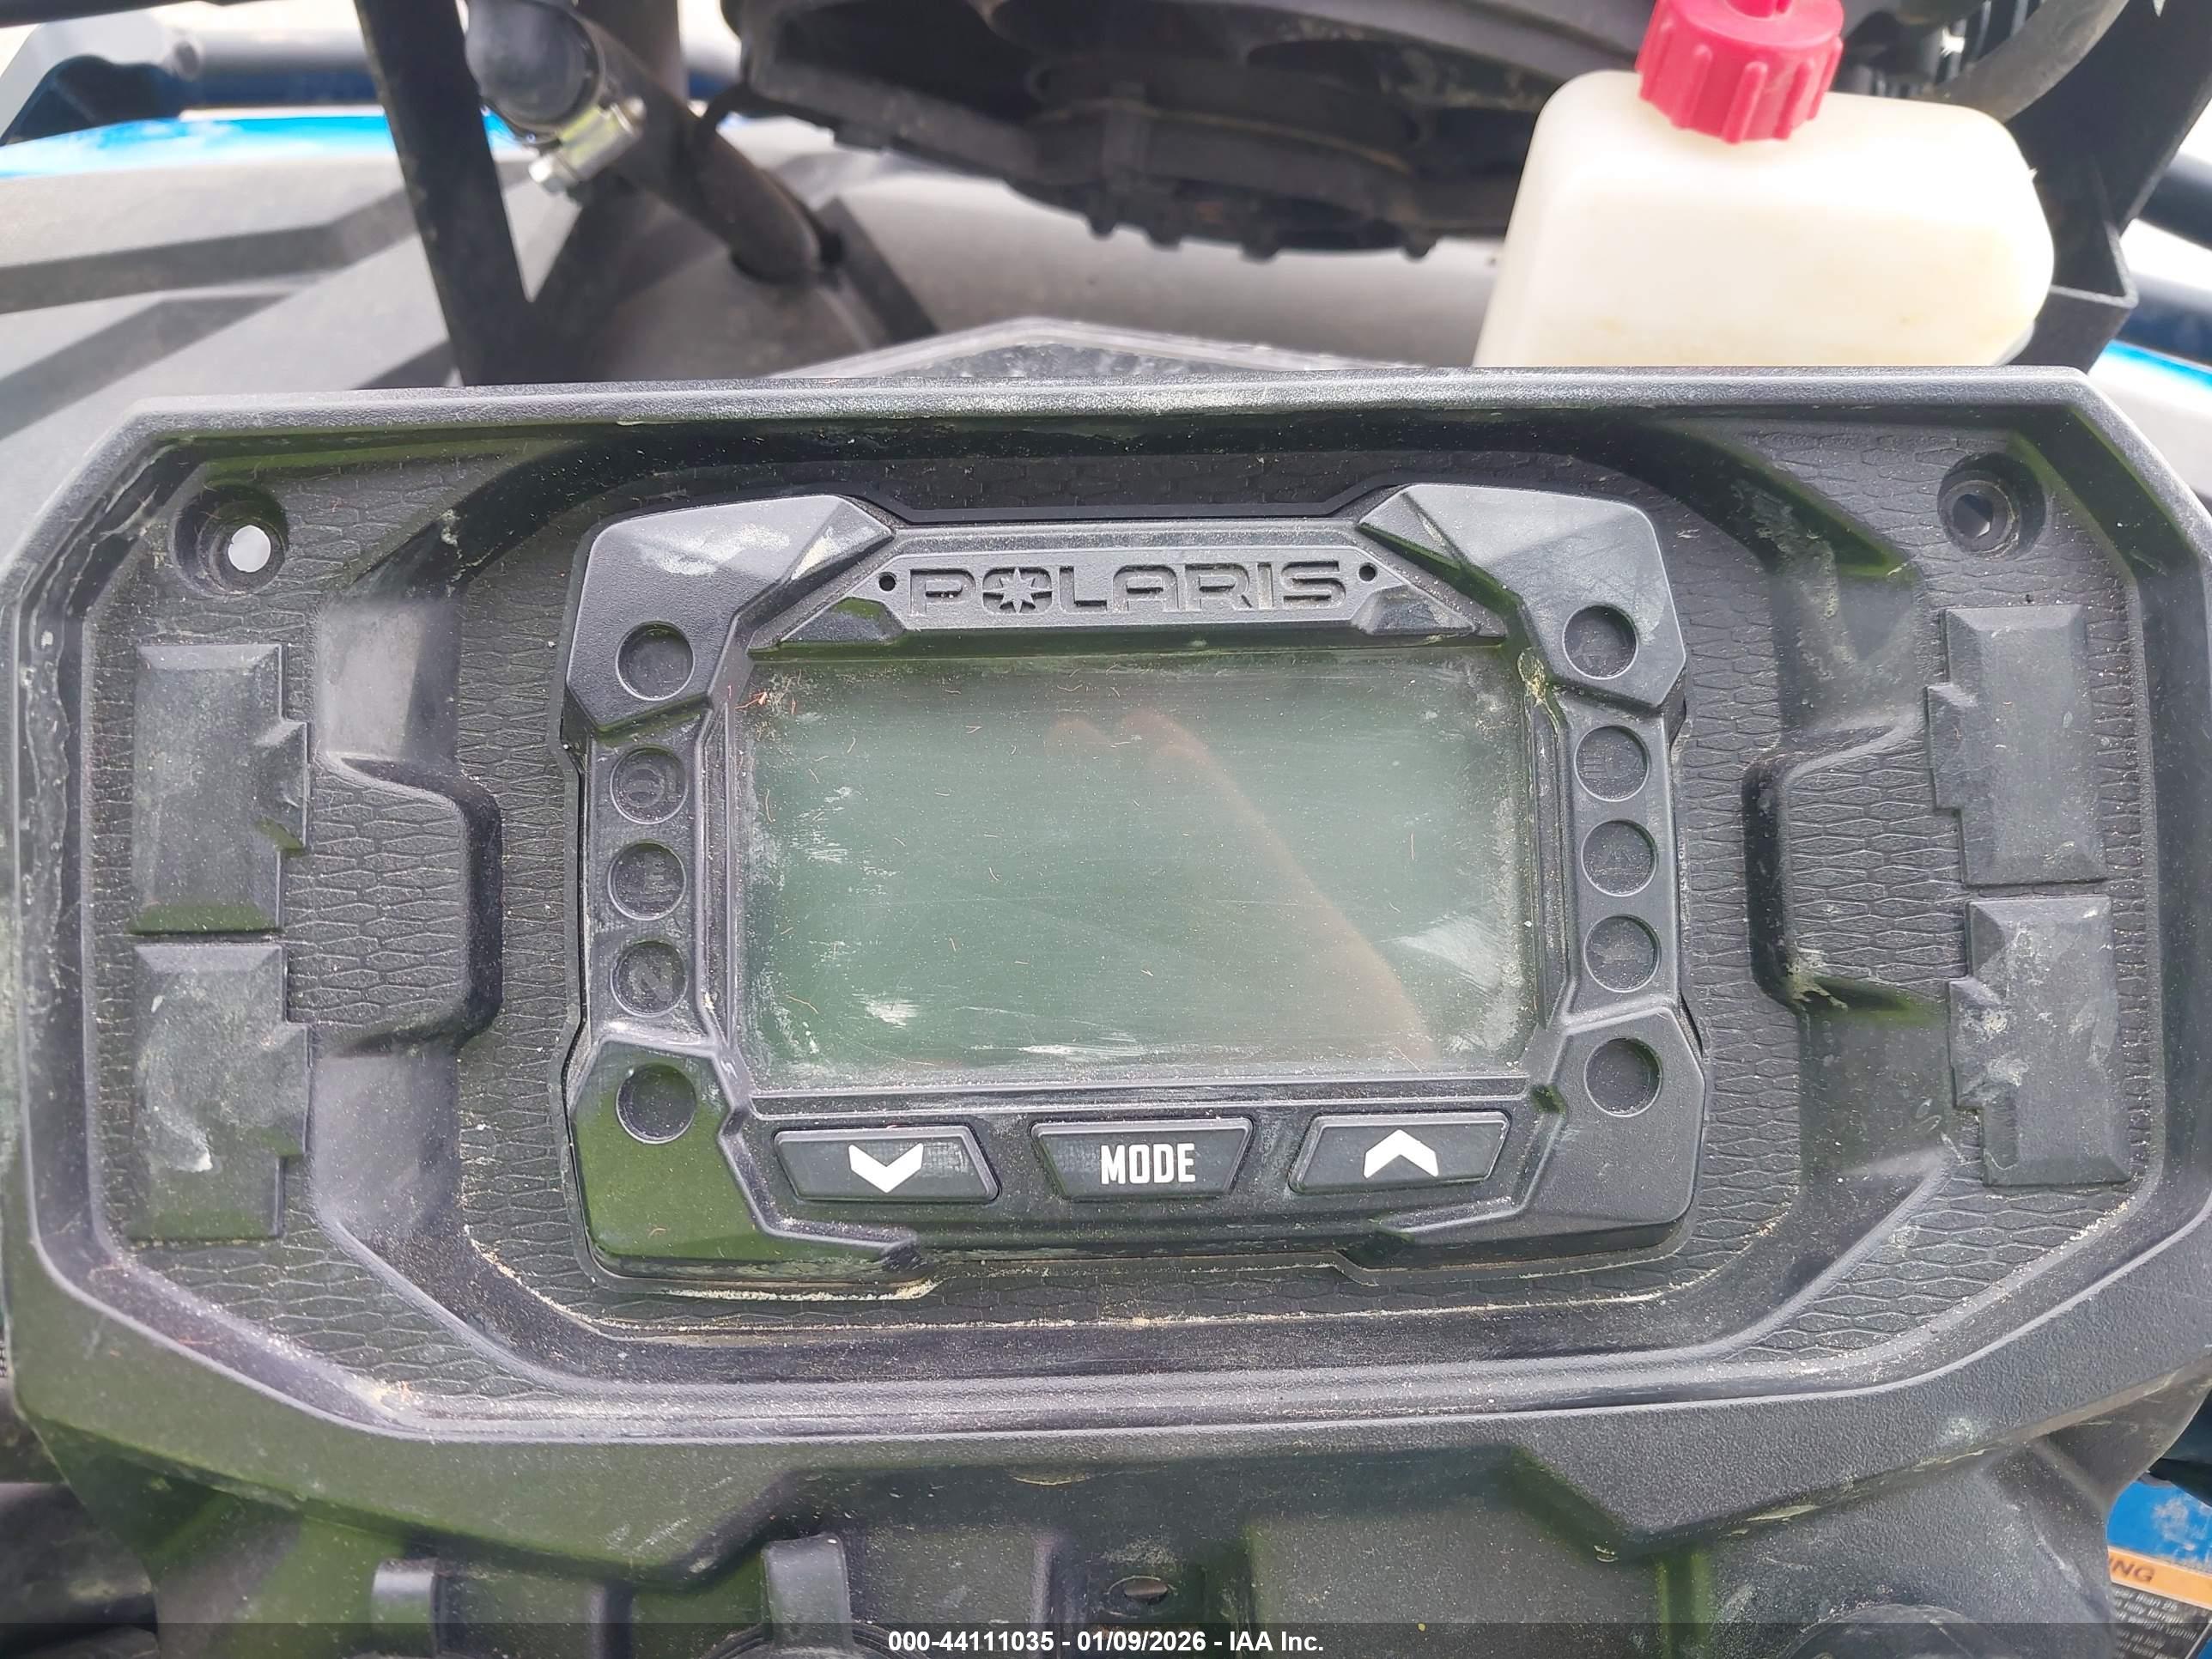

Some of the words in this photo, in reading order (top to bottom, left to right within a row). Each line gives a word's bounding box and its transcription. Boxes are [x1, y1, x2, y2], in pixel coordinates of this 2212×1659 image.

[909, 560, 1346, 616] POLARIS
[1101, 1143, 1196, 1185] MODE
[2109, 1557, 2155, 1583] NG
